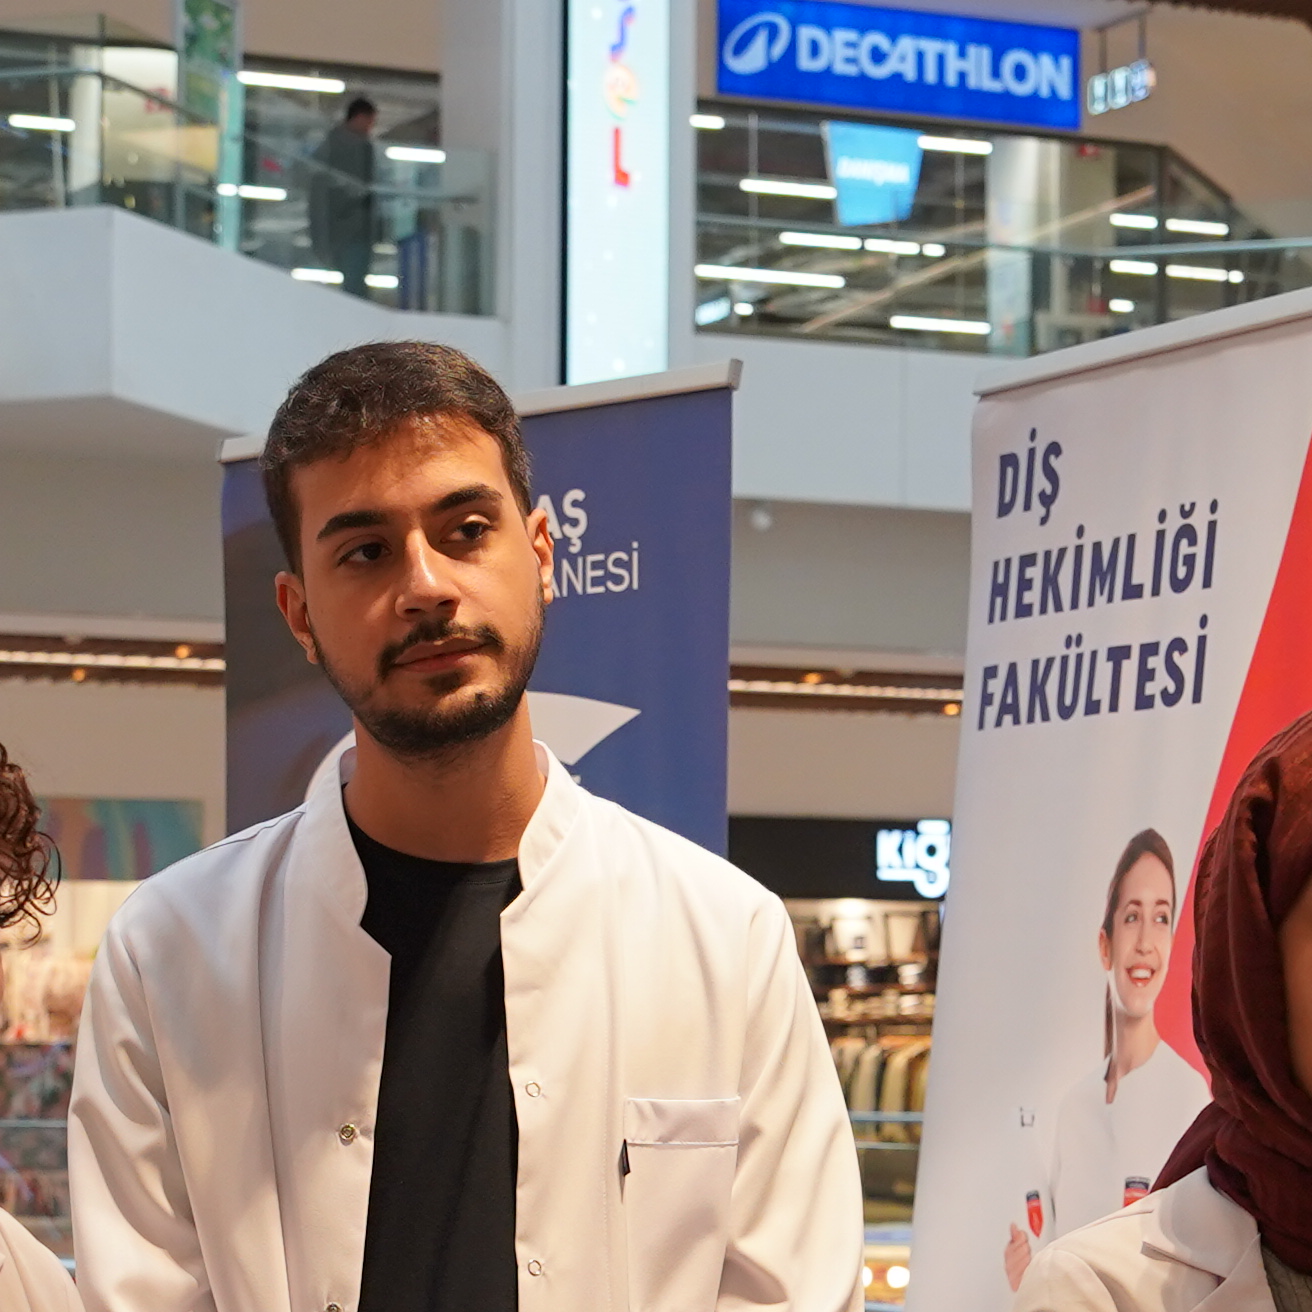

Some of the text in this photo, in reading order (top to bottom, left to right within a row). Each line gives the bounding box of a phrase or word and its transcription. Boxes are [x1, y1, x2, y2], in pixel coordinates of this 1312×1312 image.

[794, 23, 1074, 100] DECATHLON
[996, 427, 1063, 527] DİŞ
[987, 498, 1219, 625] HEKİMLİĞİ
[977, 613, 1209, 731] FAKÜLTESİ
